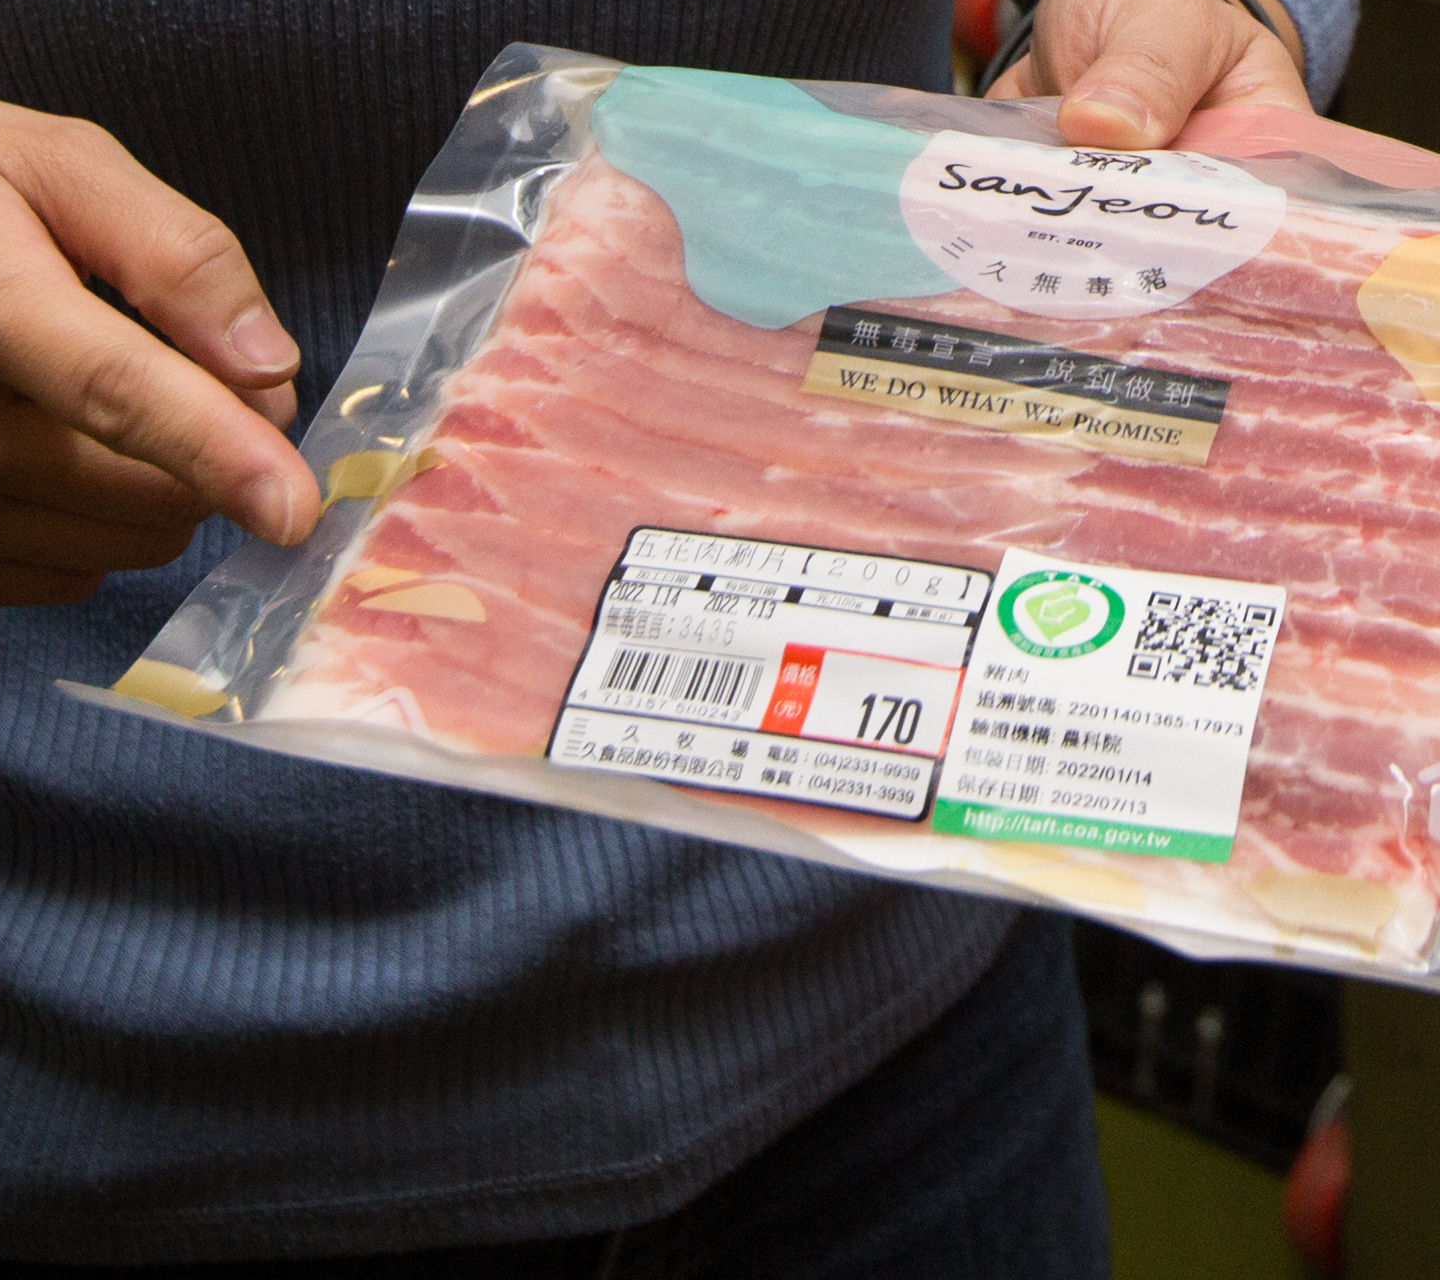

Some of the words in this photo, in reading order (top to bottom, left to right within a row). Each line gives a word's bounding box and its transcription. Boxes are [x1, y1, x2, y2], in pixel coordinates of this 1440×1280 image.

[1027, 230, 1061, 244] EST.
[1066, 237, 1104, 251] 2007
[839, 368, 879, 393] WE
[887, 376, 926, 401] DO
[937, 385, 1014, 415] WHAT
[1023, 401, 1063, 427] WE
[1073, 412, 1184, 446] PROMISE
[578, 689, 588, 700] 4
[773, 700, 803, 719] (元)
[857, 693, 922, 745] 170
[562, 739, 745, 781] 三久食品股份有限公司
[1057, 760, 1153, 786] 2022/01/14
[1050, 789, 1148, 815] 2022/07/13
[963, 806, 1172, 849] http://taft.coa.gov.tw
